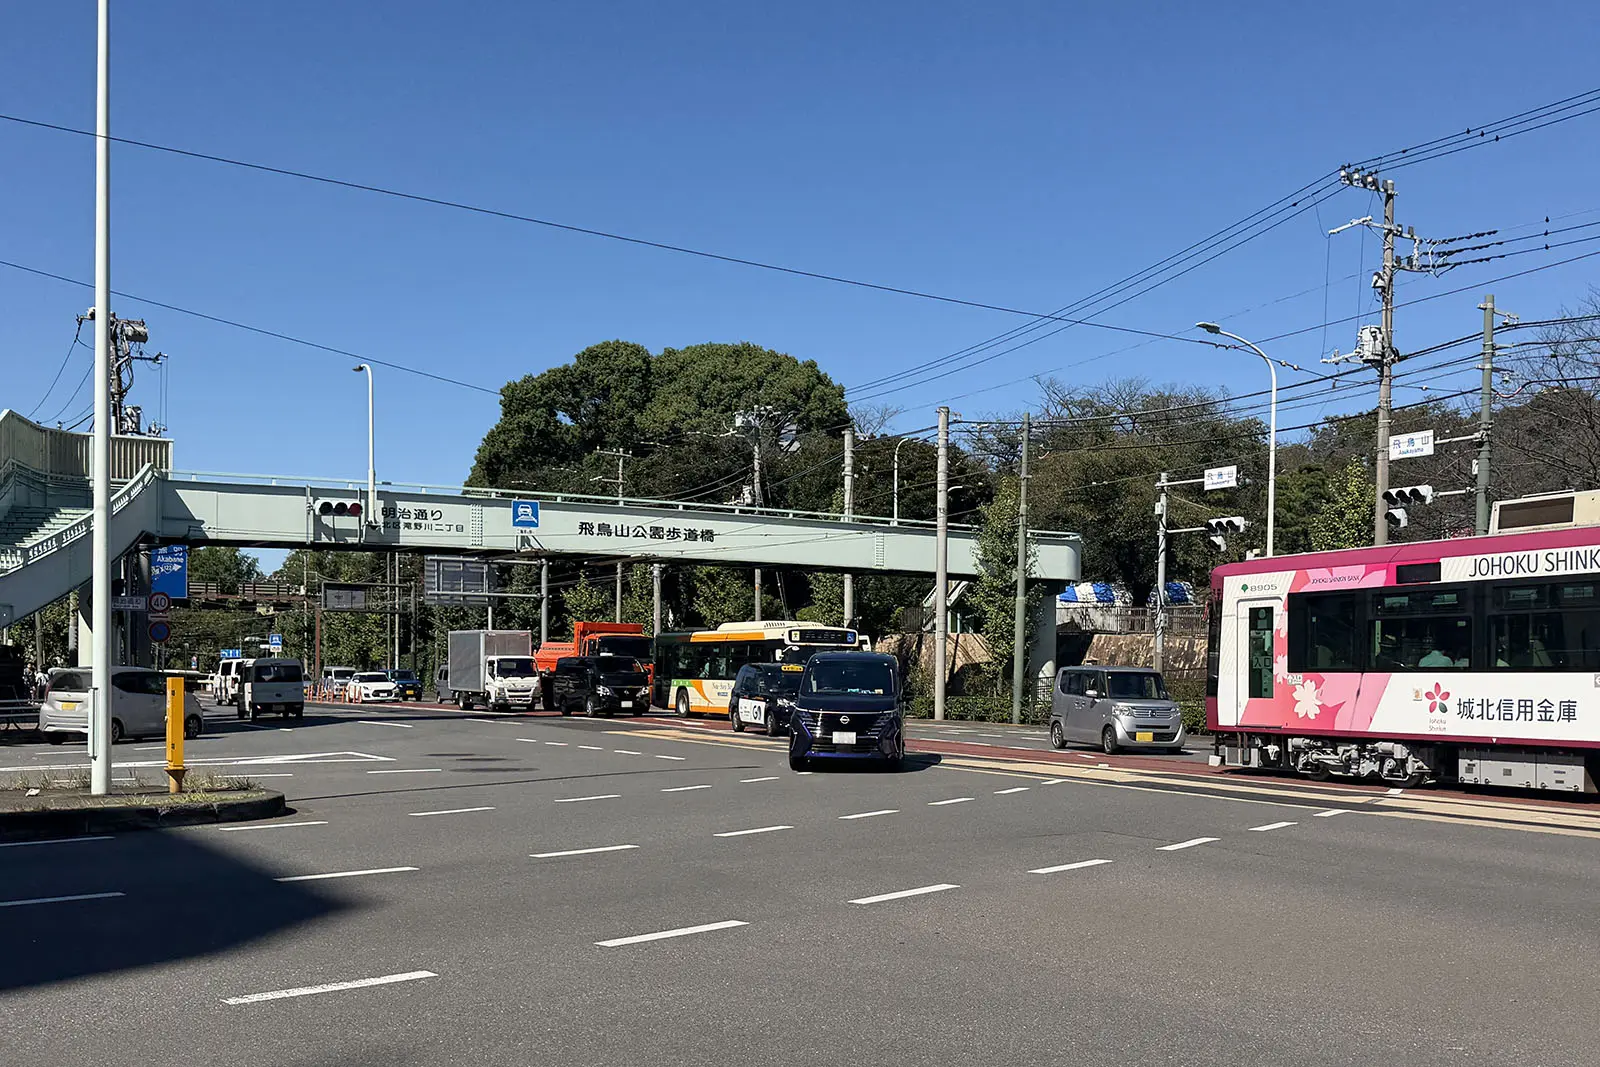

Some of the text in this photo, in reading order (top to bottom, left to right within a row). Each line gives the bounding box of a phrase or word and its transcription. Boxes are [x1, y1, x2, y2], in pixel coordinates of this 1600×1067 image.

[381, 507, 443, 521] 明治通り
[578, 521, 715, 543] 飛鳥山公園歩道橋
[156, 555, 185, 563] Akabane
[1469, 549, 1600, 578] JOHOKU SHINK
[1250, 584, 1278, 592] 8905
[153, 597, 167, 608] 40
[1254, 657, 1271, 668] 入口
[1456, 698, 1578, 723] 城北信用金庫
